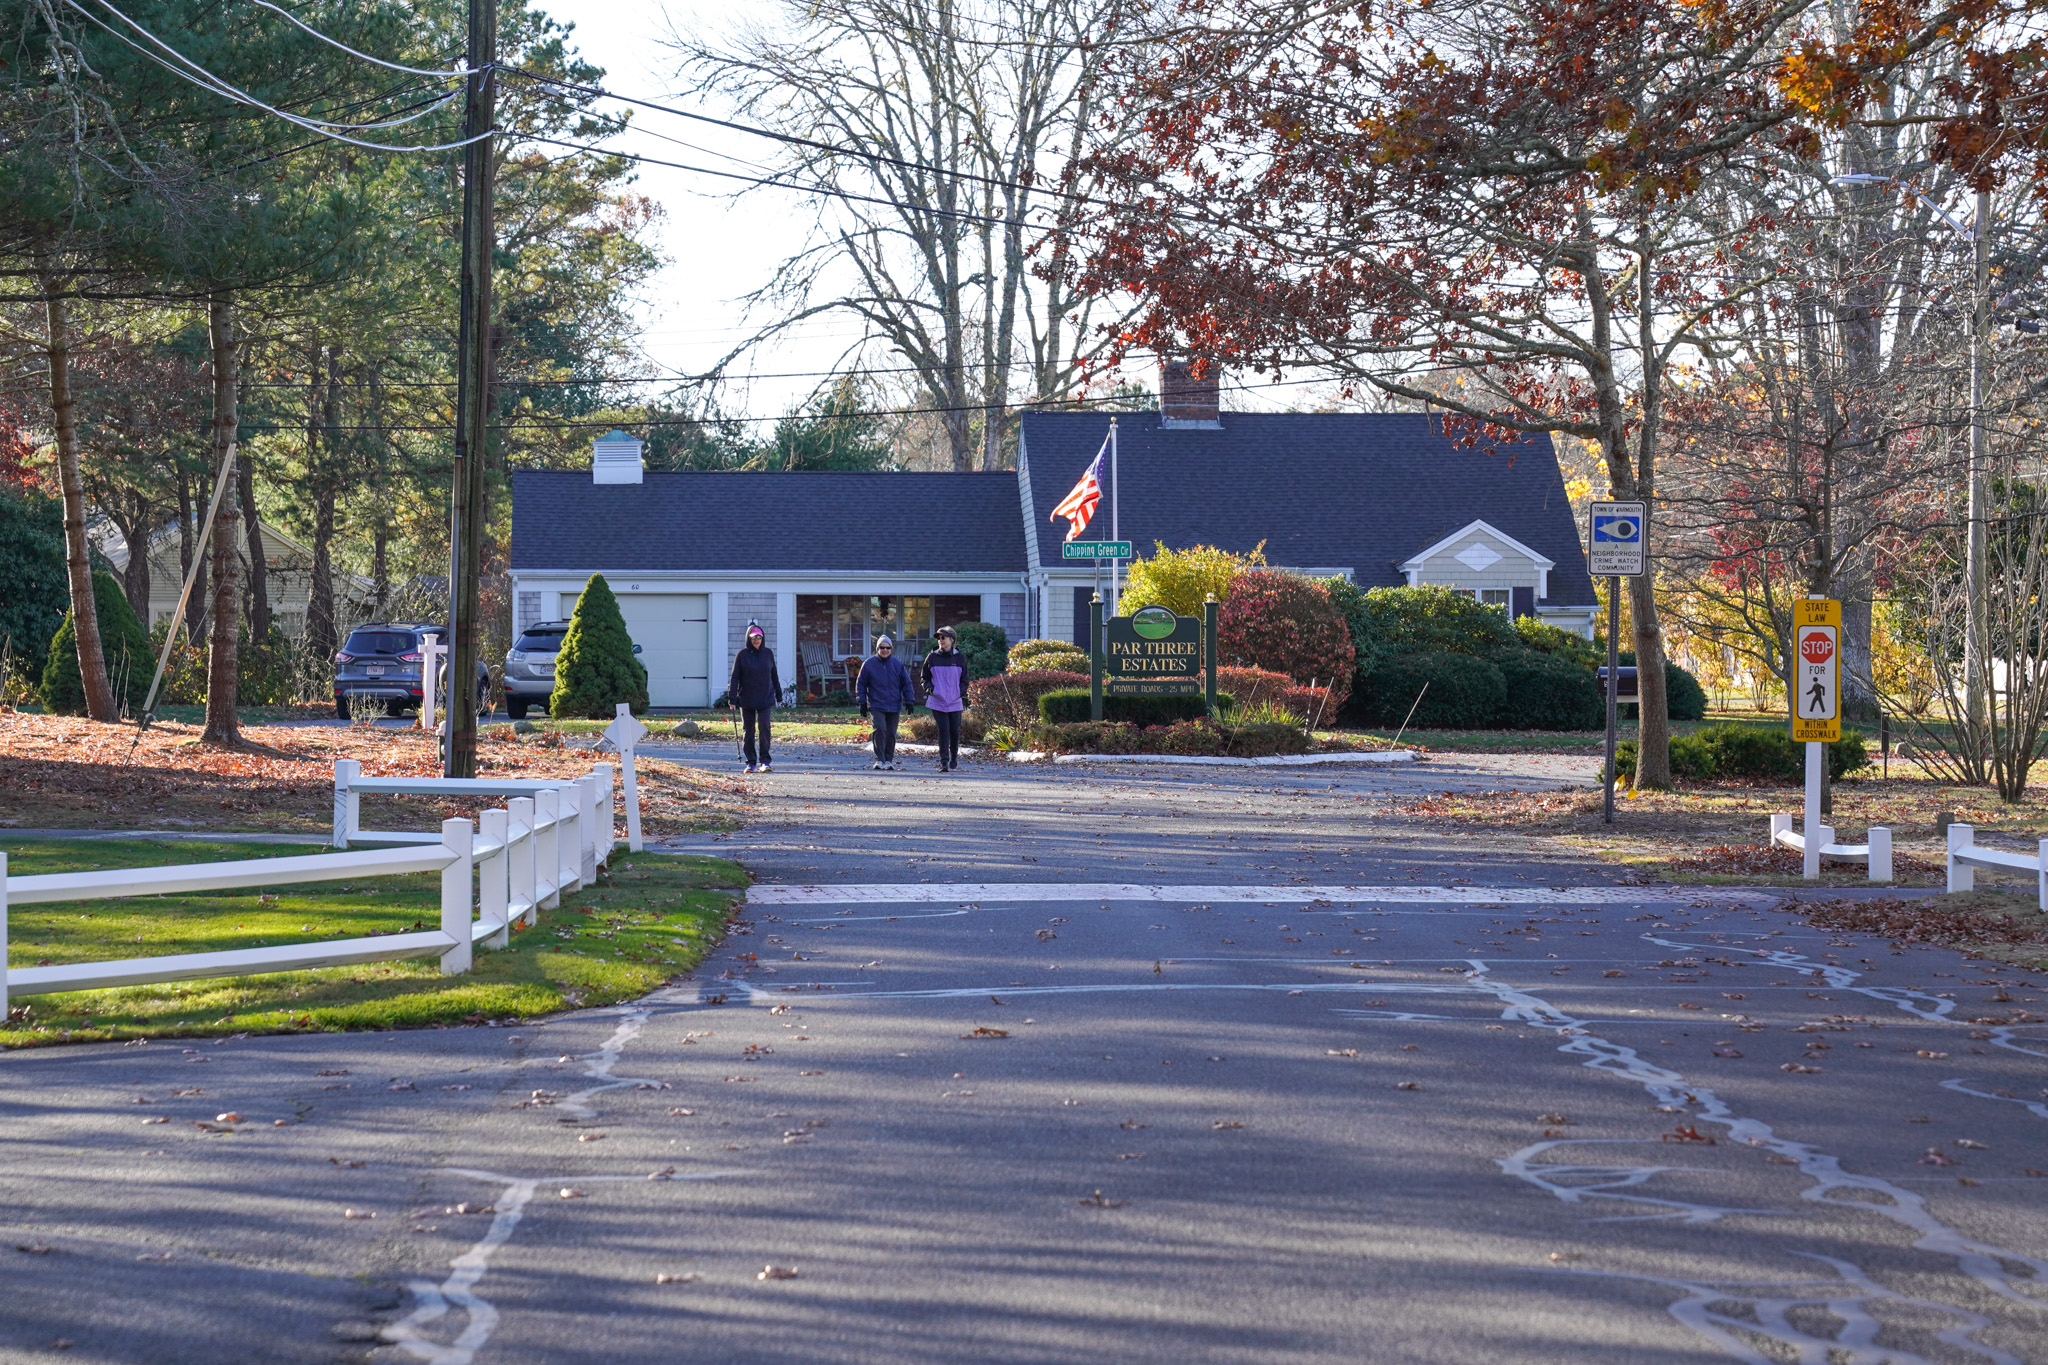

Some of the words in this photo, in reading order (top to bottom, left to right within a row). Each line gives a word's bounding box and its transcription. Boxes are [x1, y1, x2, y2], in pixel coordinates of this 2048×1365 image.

[1066, 544, 1094, 557] Chipping
[1098, 544, 1117, 556] Green
[1805, 603, 1830, 612] STATE
[1809, 614, 1826, 622] LAW
[1112, 642, 1141, 655] PAR
[1144, 642, 1196, 655] THREE
[1802, 641, 1832, 654] STOP
[1122, 658, 1187, 671] ESTATES
[1809, 666, 1826, 674] FOR
[1804, 720, 1828, 729] WITHIN
[1796, 730, 1836, 739] CROSSWALK
